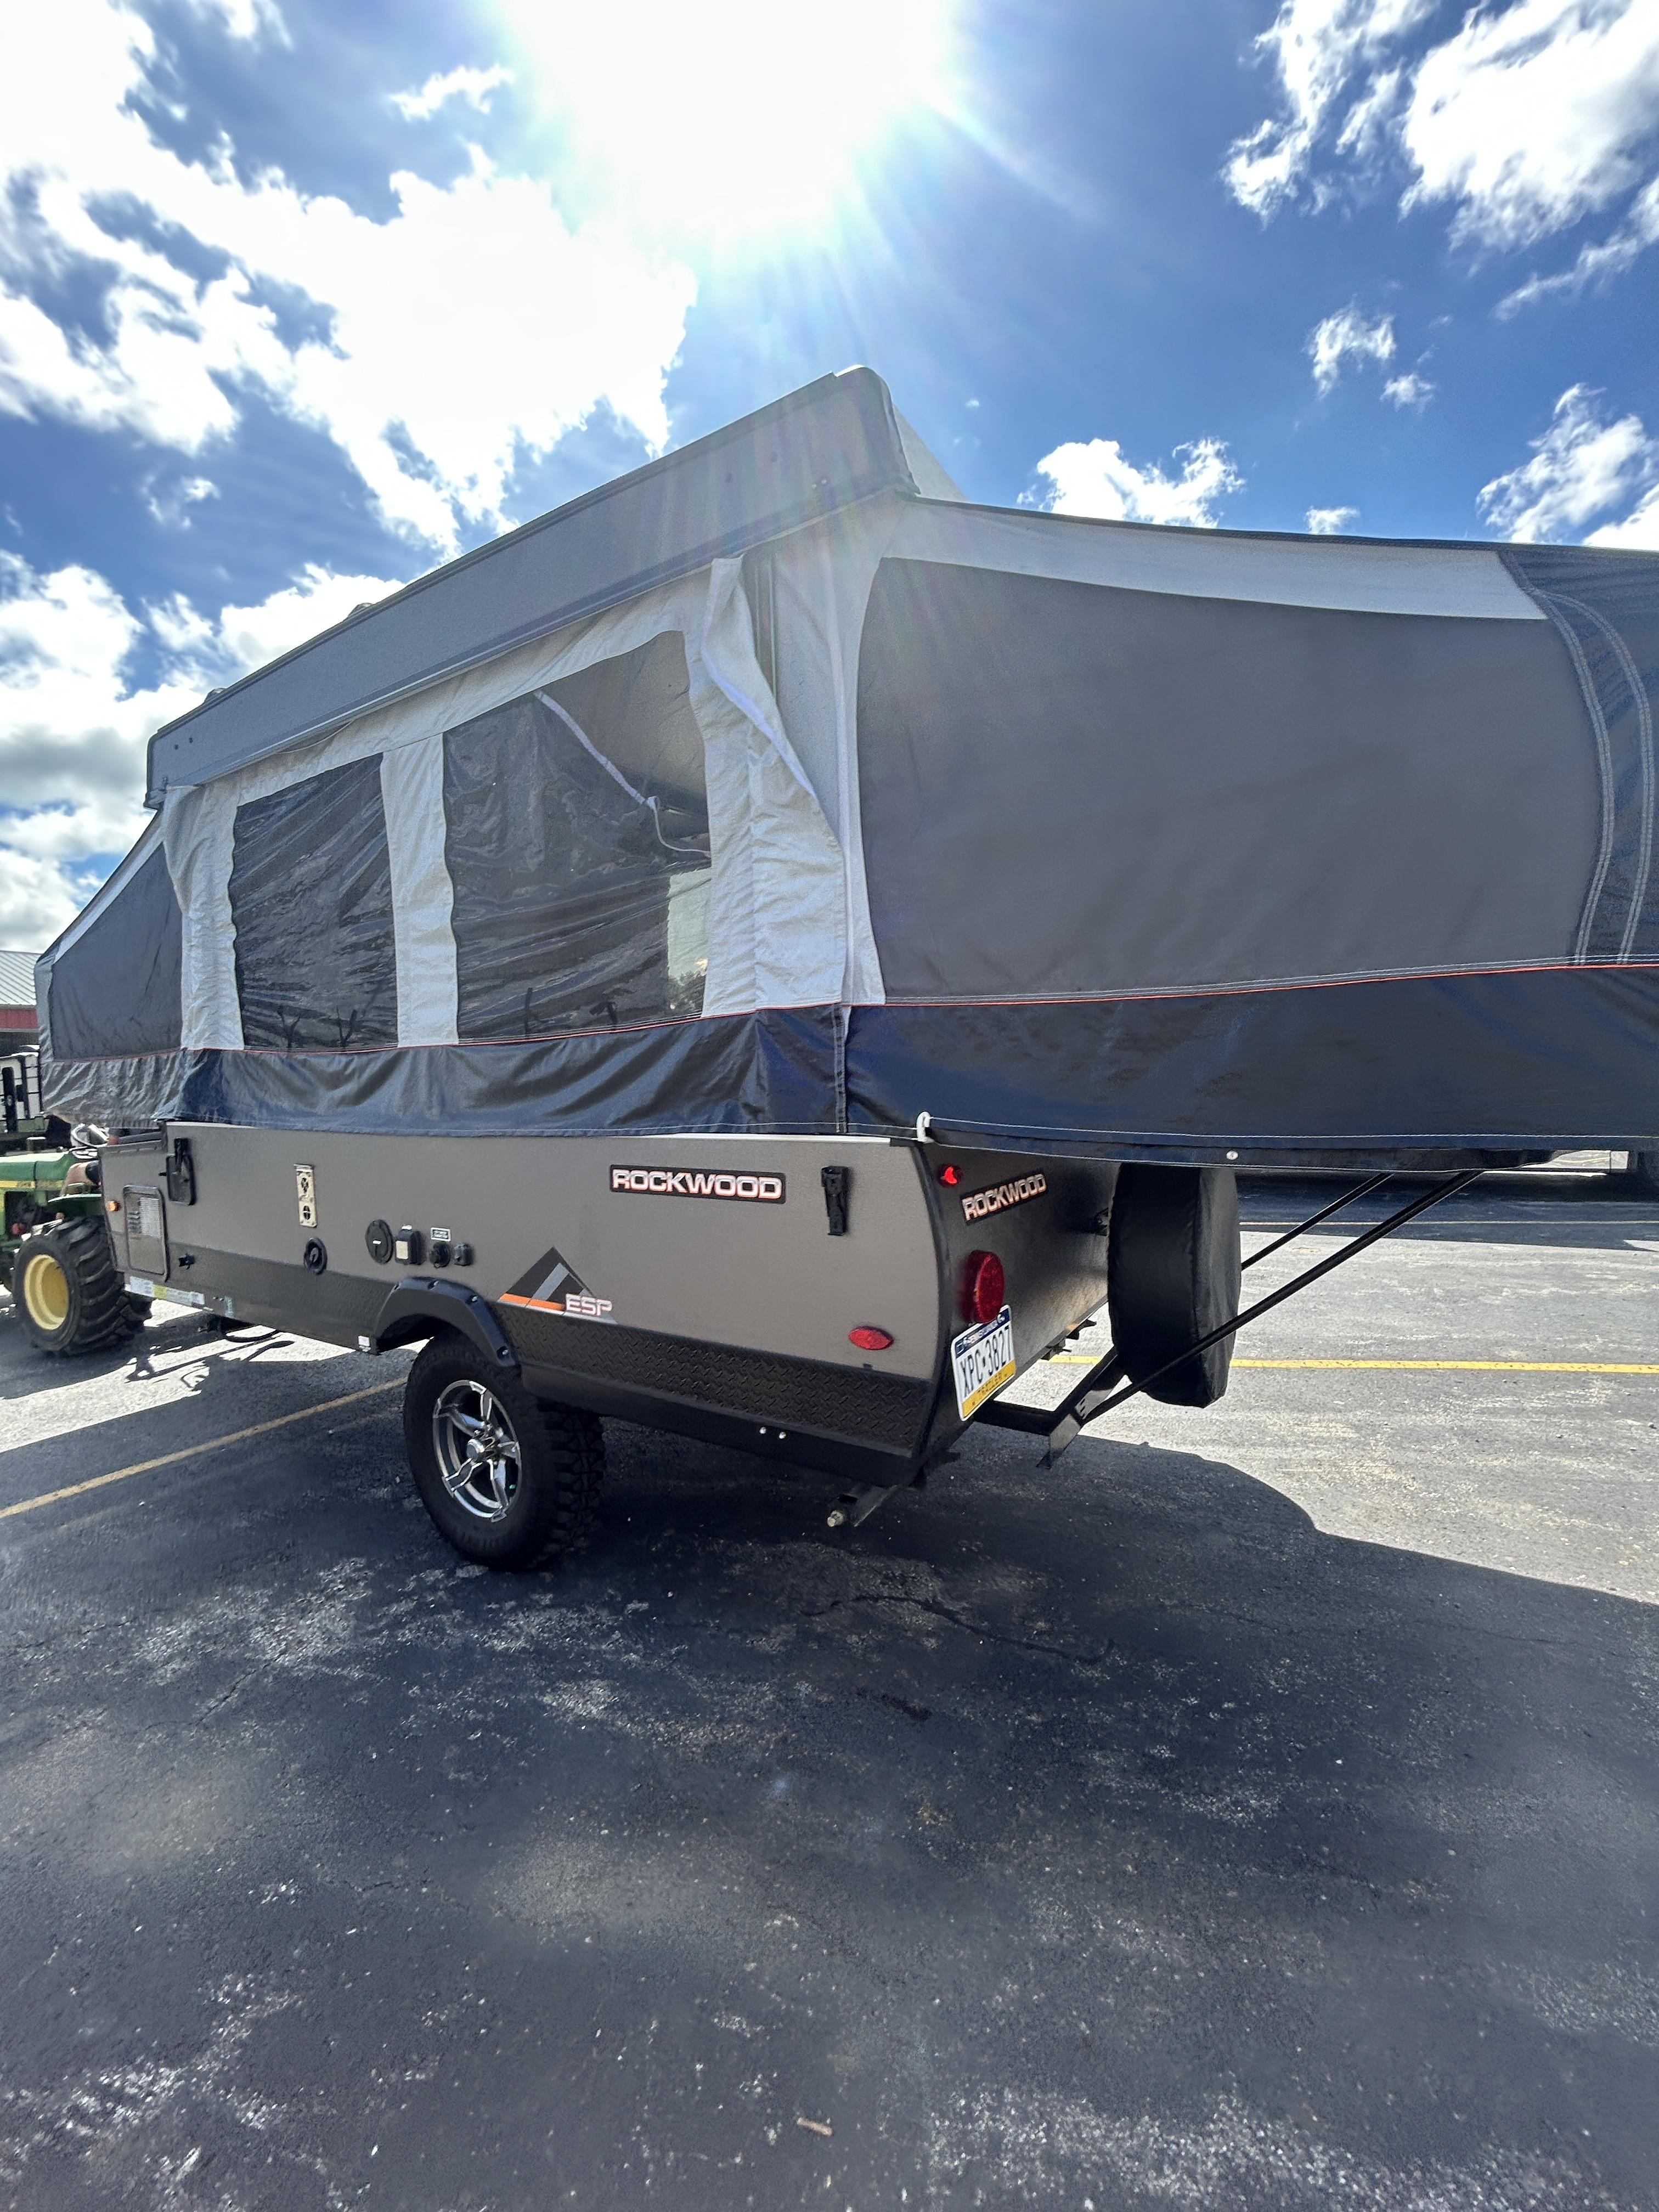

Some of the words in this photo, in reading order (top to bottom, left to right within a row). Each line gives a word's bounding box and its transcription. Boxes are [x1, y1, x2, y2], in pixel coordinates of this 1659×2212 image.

[612, 1169, 782, 1199] ROCKWOOD
[961, 1173, 1047, 1221] ROCKWOOD
[566, 1293, 613, 1316] ESP
